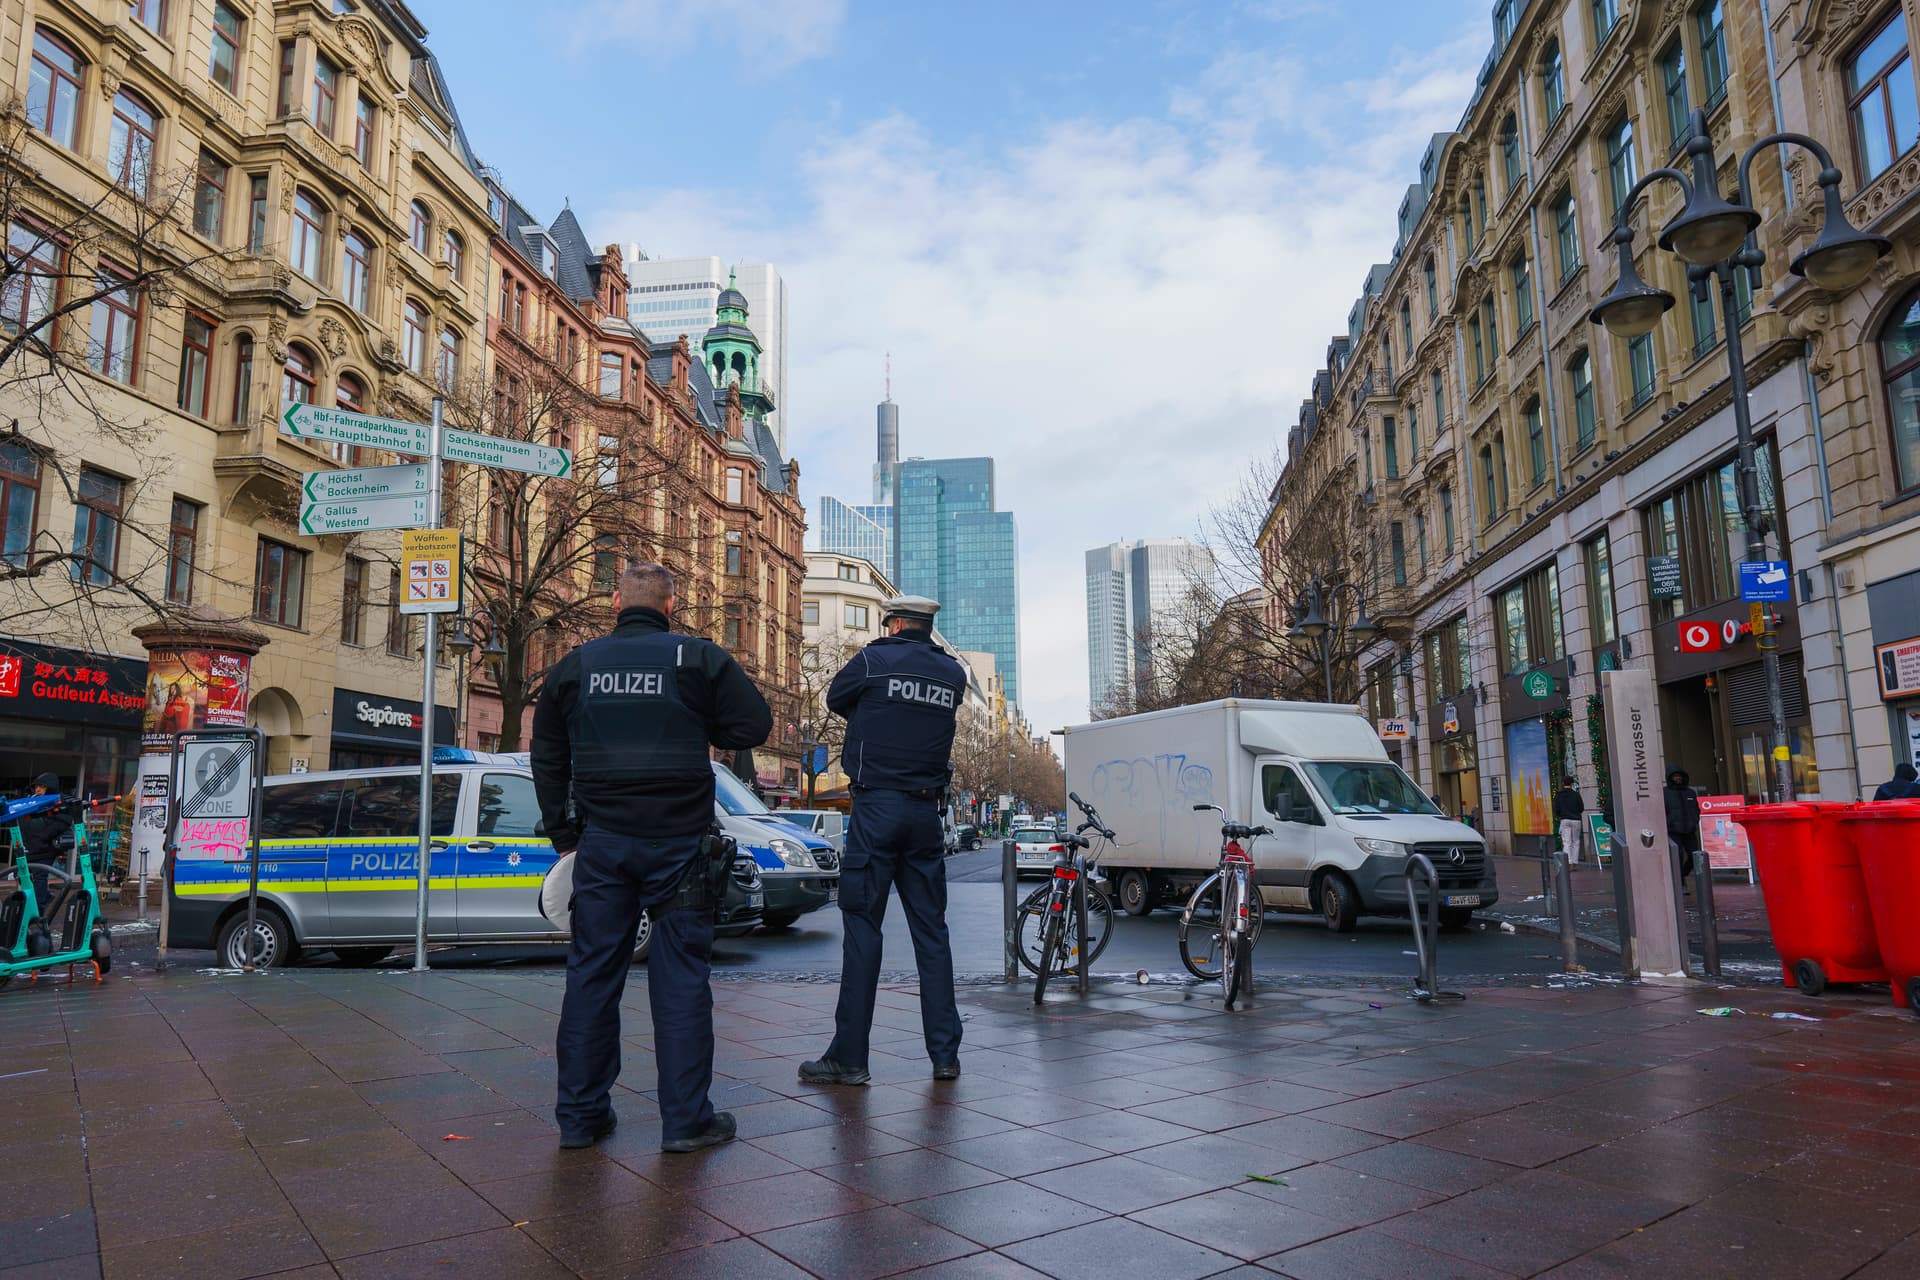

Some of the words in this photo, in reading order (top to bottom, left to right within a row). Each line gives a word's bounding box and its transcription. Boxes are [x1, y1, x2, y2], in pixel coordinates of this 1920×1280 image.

[313, 410, 408, 436] Hbf-Fahrradparkhaus
[329, 426, 412, 449] Hauptbahnhof
[448, 433, 530, 456] Sachsenhausen
[447, 445, 503, 463] Innenstadt
[328, 473, 363, 485] Höchst
[327, 483, 390, 497] Bockenheim
[325, 506, 358, 516] Gallus
[325, 516, 370, 529] Westend
[414, 533, 449, 543] Waffen-
[404, 543, 457, 552] verbotszone
[589, 673, 663, 695] POLIZEI
[32, 681, 95, 703] Gutleut
[888, 679, 955, 709] POLIZEI
[1386, 721, 1404, 732] dm
[1630, 706, 1650, 801] Trinkwasser
[200, 800, 233, 814] ZONE
[264, 863, 278, 873] 110
